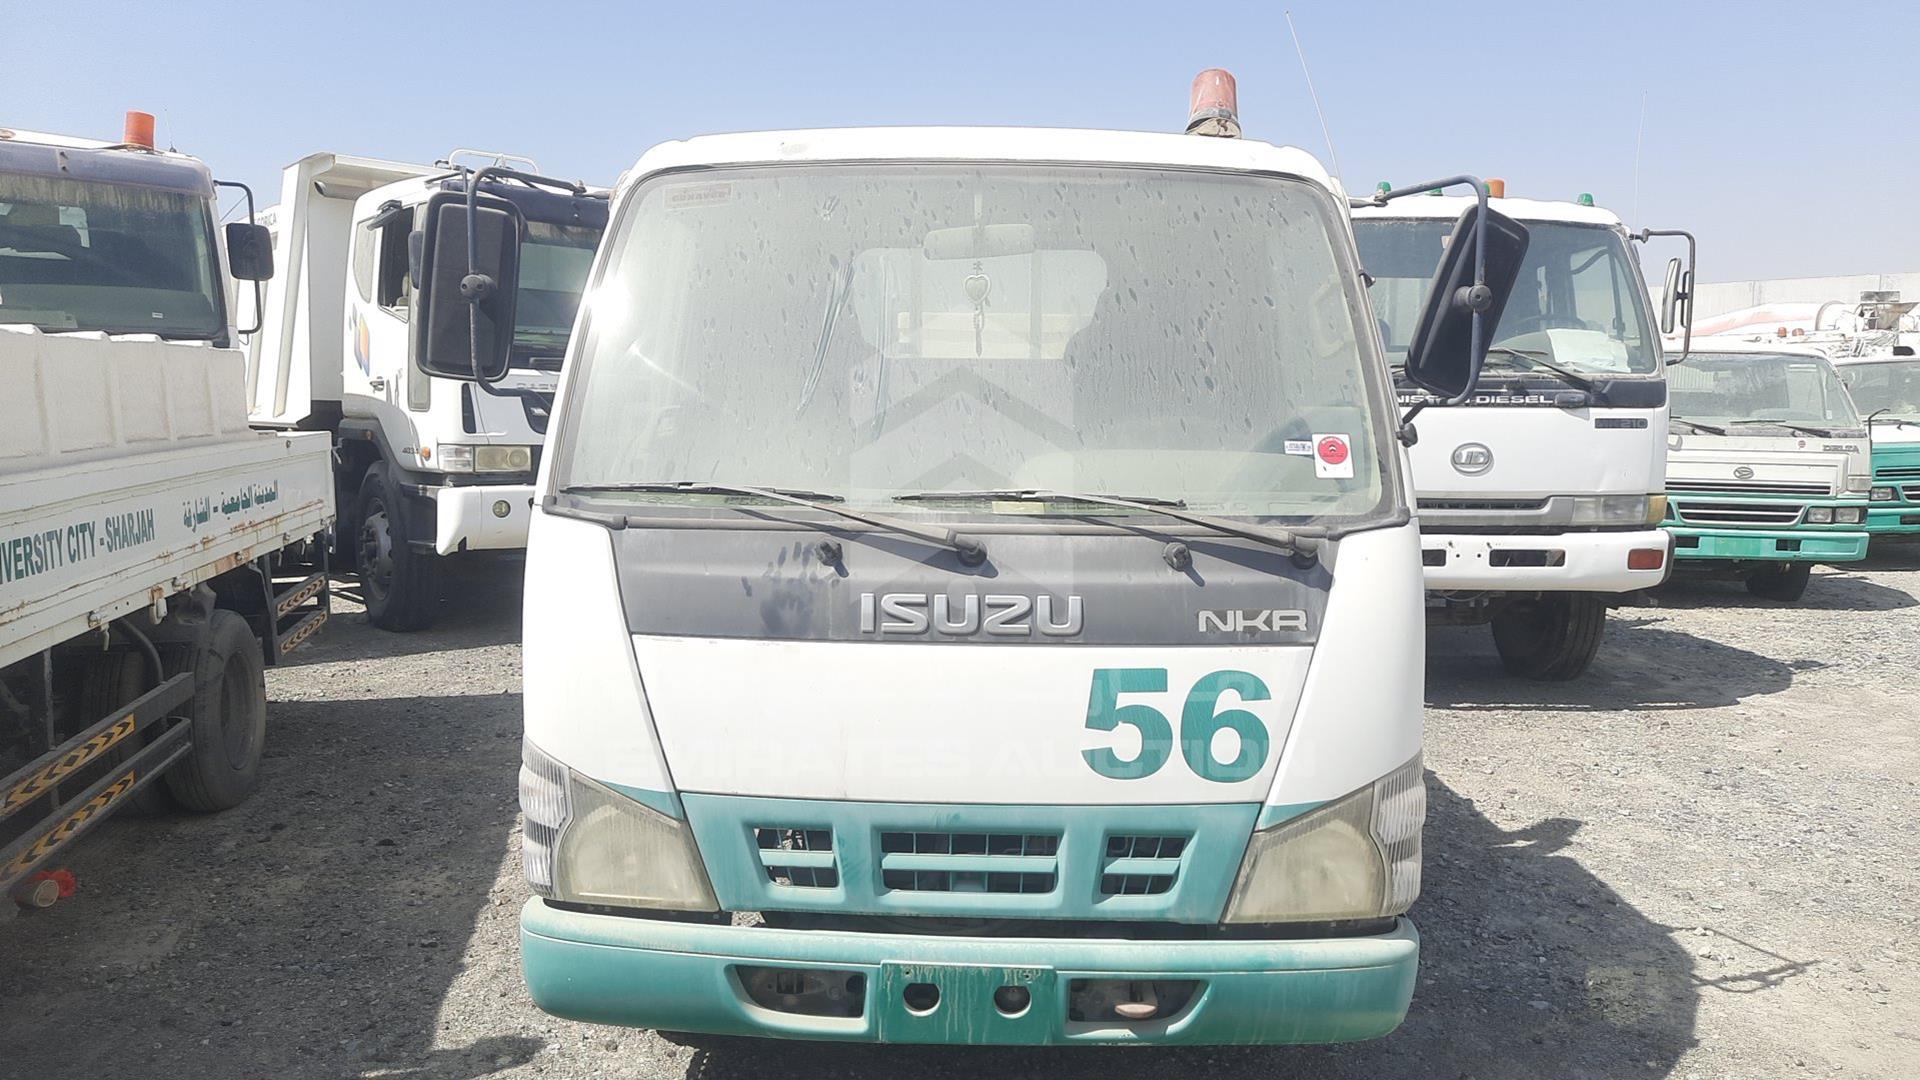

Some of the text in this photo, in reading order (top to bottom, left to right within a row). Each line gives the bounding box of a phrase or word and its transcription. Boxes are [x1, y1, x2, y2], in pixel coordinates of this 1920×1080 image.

[1474, 394, 1554, 404] DIESEL
[221, 486, 253, 521] الجامعية
[254, 480, 278, 510] المدينة
[183, 496, 210, 533] الشارقة
[67, 521, 96, 564] CITY
[105, 508, 155, 553] SHARJAH
[859, 593, 1084, 636] ISUZU
[1198, 609, 1309, 633] NKR
[1081, 667, 1271, 782] 56
